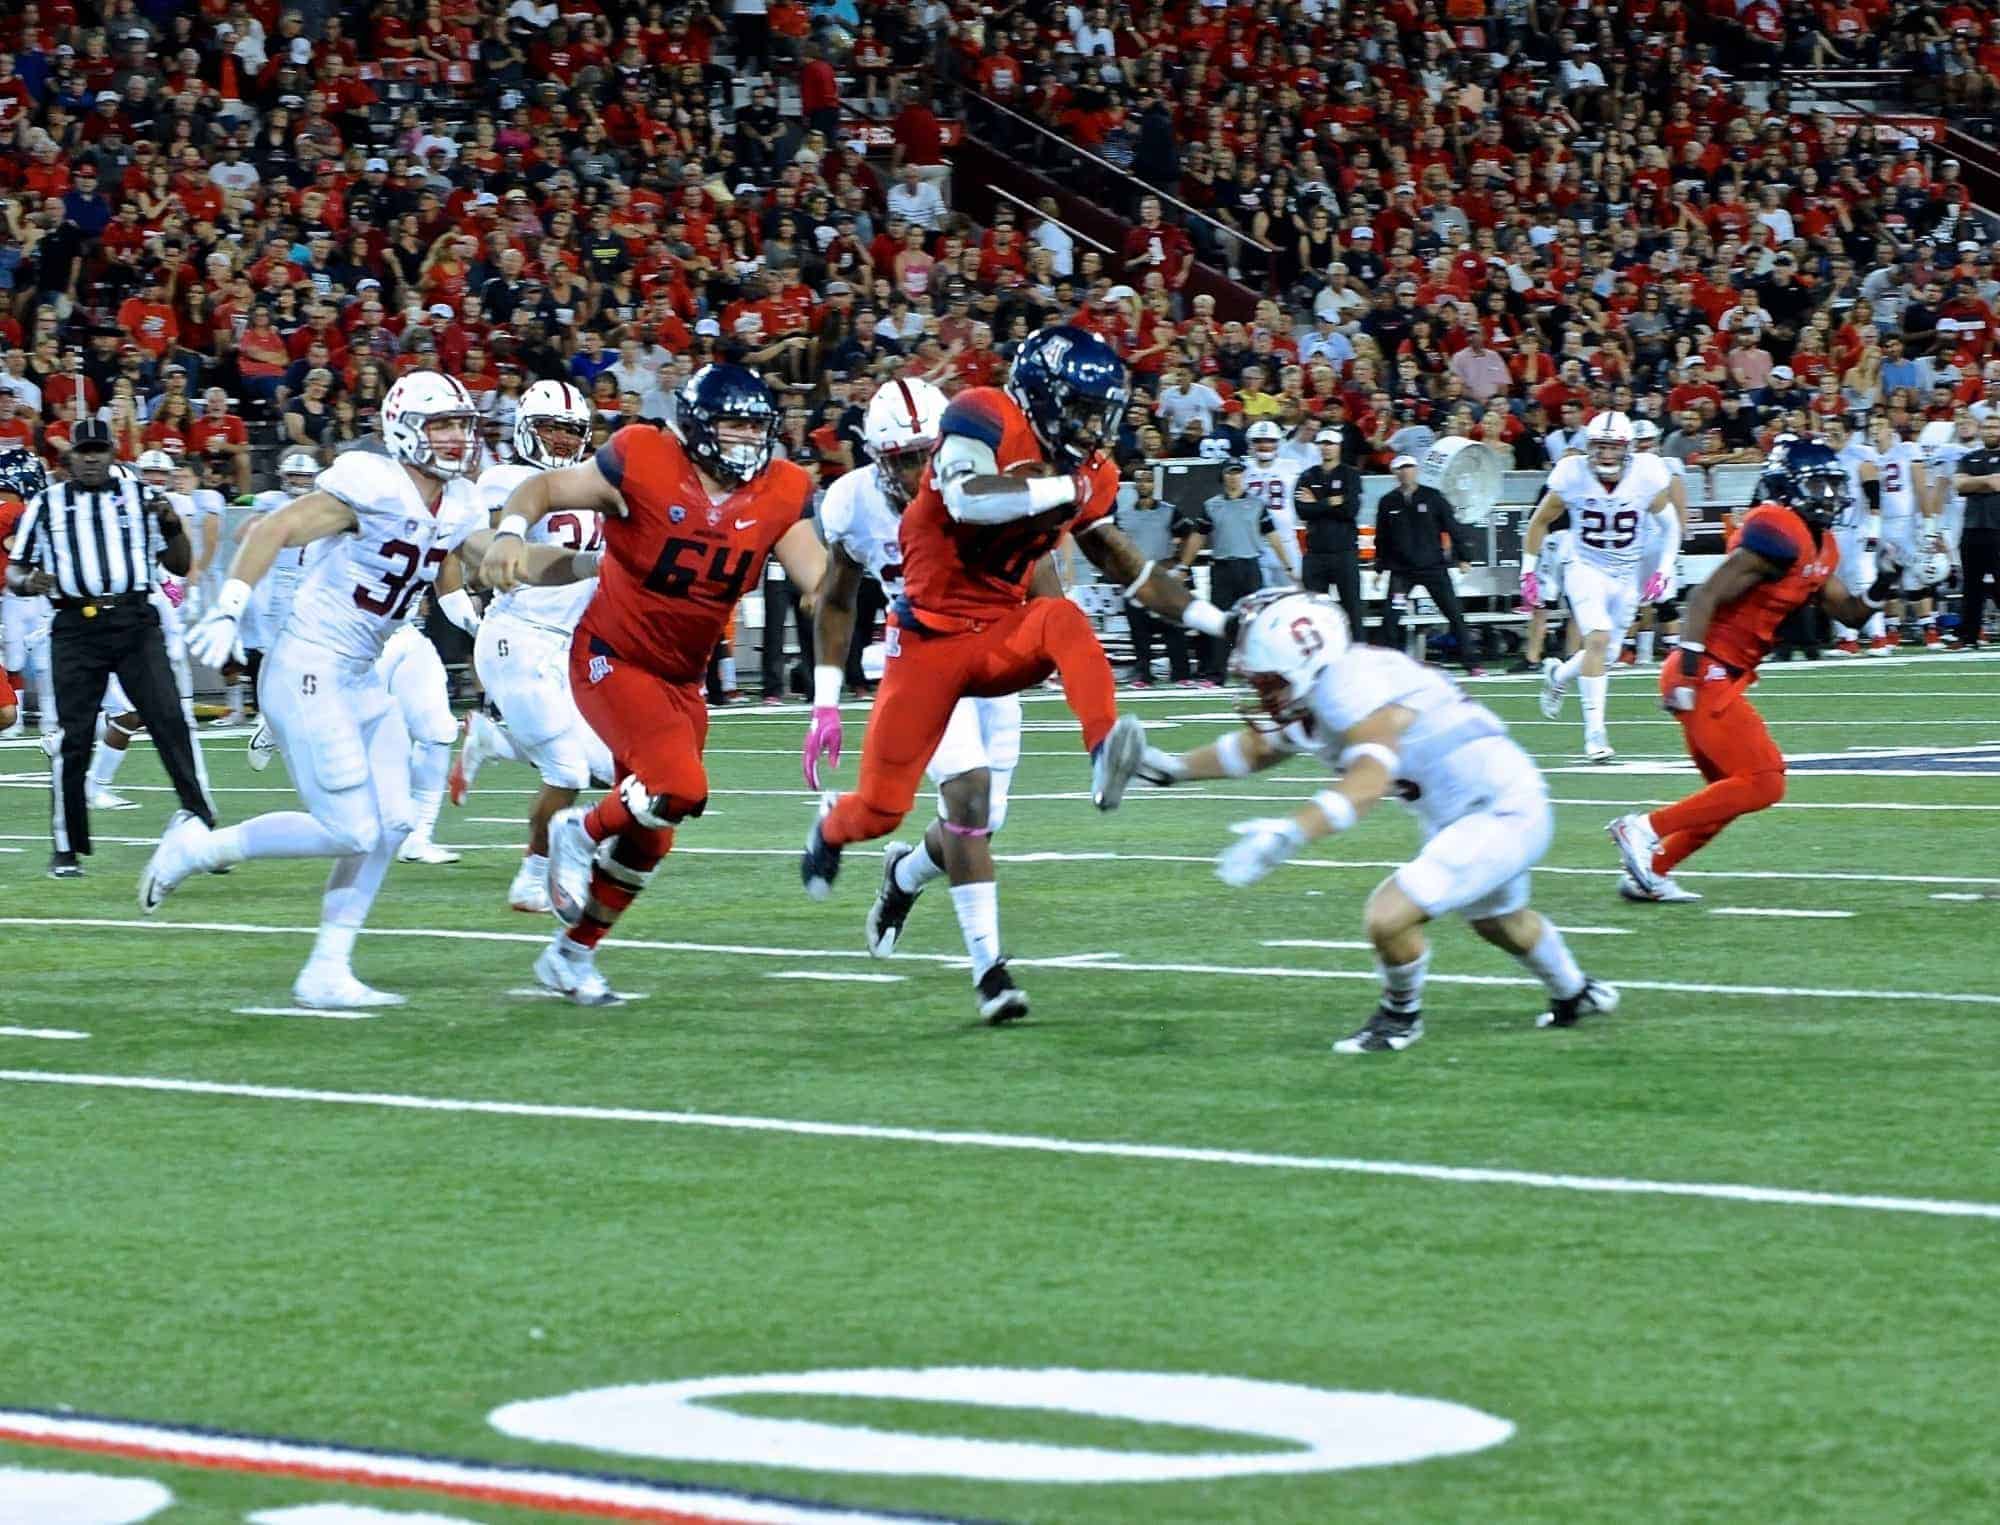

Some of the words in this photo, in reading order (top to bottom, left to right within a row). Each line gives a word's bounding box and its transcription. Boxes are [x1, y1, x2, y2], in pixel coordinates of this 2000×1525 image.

[1580, 509, 1639, 549] 29
[352, 538, 449, 620] 32
[643, 536, 756, 604] 64
